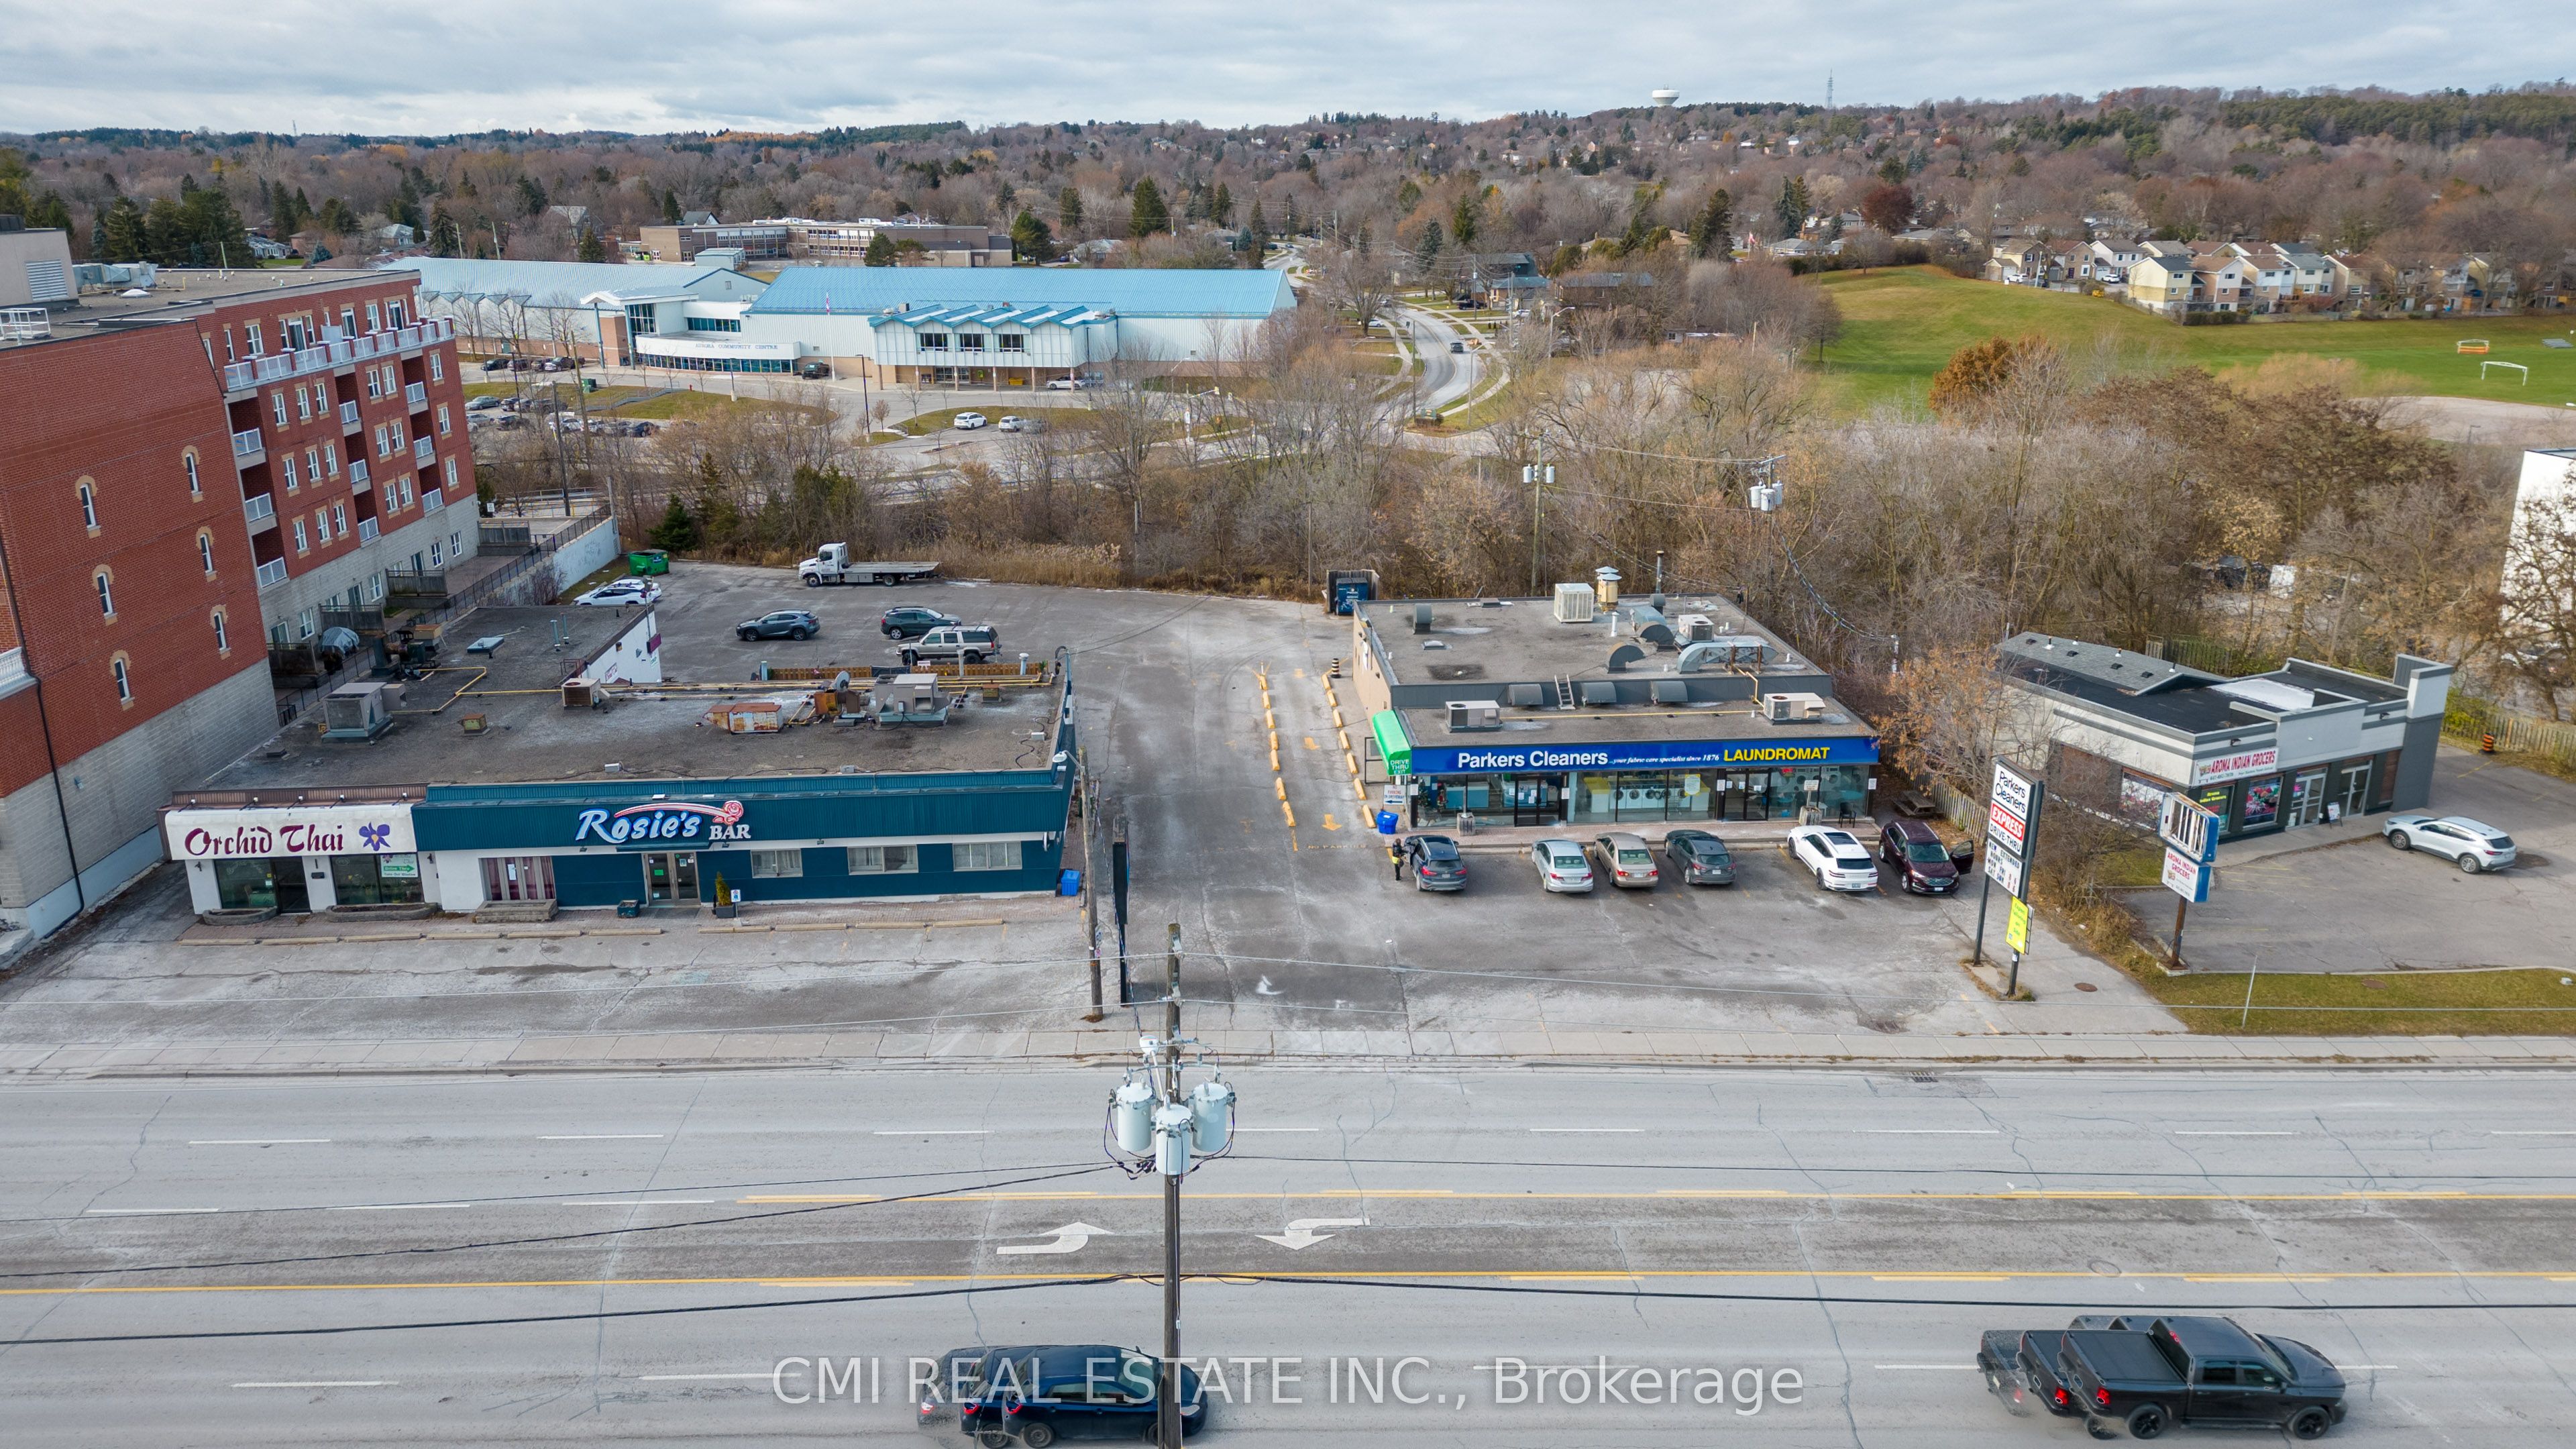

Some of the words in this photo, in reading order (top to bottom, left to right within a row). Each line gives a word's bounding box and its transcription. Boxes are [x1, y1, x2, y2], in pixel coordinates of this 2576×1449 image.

[1458, 751, 1525, 769] Parkers
[1529, 749, 1609, 767] Cleaners
[1660, 756, 1686, 764] specialist
[1723, 747, 1830, 762] LAUNDROMAT
[2210, 758, 2231, 773] AROMA
[2232, 755, 2251, 770] INDIAN
[2252, 750, 2275, 766] GROCERS
[1999, 770, 2026, 798] Parkers
[1995, 782, 2026, 813] Cleaners
[575, 808, 702, 844] Rosie's
[708, 824, 751, 840] BAR
[1992, 806, 2023, 838] EXPRESS
[184, 826, 272, 856] Orchid
[279, 824, 344, 852] Thai
[1990, 823, 2021, 853] DRIVE-THRU
[1990, 851, 2003, 865] HOURS
[2000, 849, 2020, 869] EXTENDED
[2167, 852, 2182, 865] AROMA
[2182, 861, 2196, 875] INDIAN
[2171, 863, 2190, 880] GROCERS
